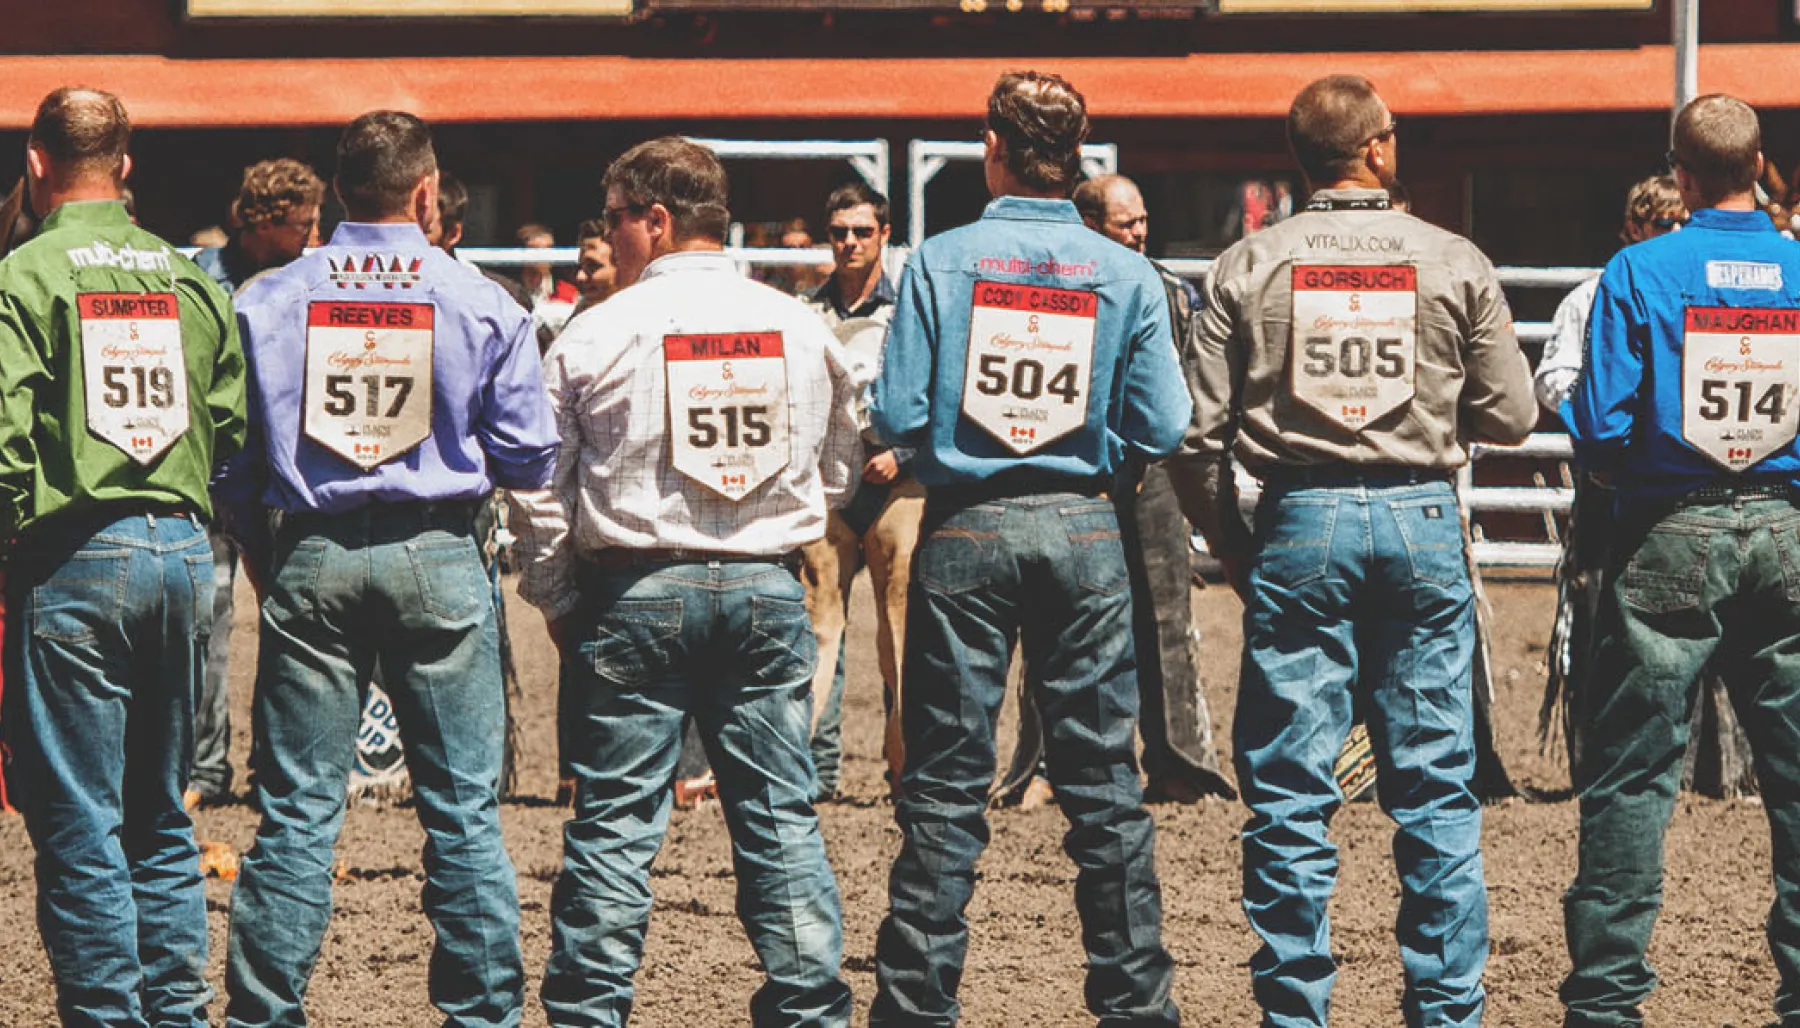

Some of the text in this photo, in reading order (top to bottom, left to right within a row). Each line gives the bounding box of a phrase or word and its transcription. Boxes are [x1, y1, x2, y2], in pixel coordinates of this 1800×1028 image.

[1305, 233, 1405, 252] VITALIX.COM
[1304, 270, 1406, 289] GORSUCH
[983, 287, 1023, 306] CODY
[91, 298, 170, 316] SUMPTER
[329, 306, 413, 325] REEVES
[1693, 312, 1797, 331] MAUGHAN
[690, 336, 760, 356] MILAN
[1303, 335, 1406, 379] 505
[103, 365, 174, 408] 519
[976, 352, 1080, 405] 504
[324, 374, 415, 417] 517
[1698, 379, 1787, 424] 514
[687, 405, 772, 448] 515
